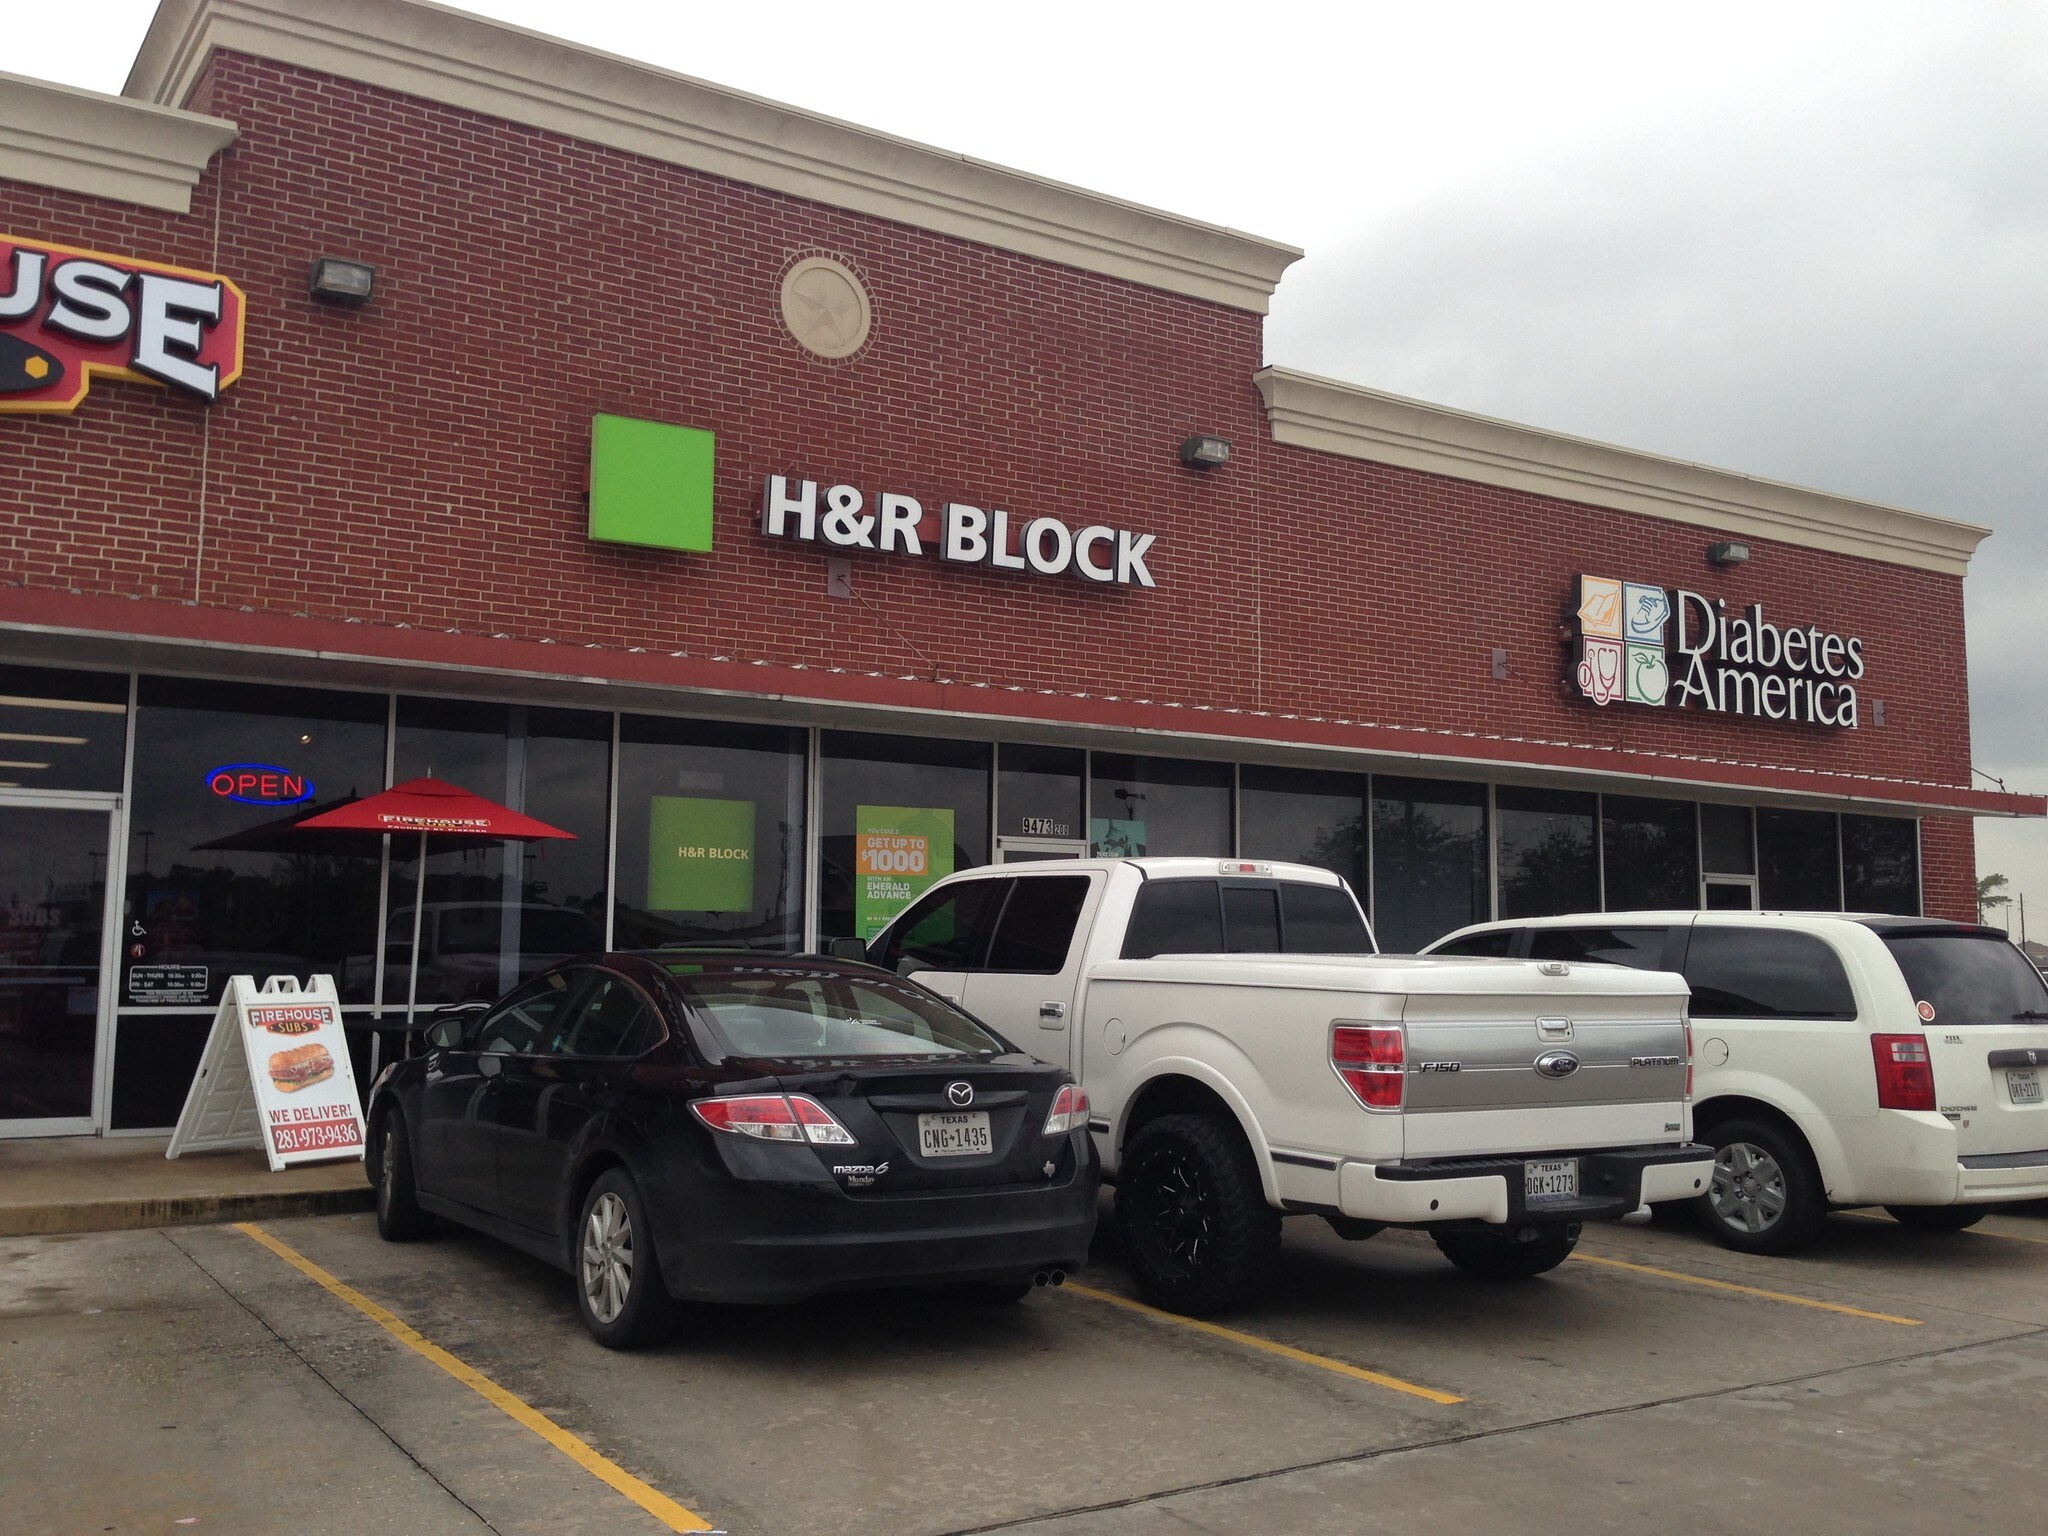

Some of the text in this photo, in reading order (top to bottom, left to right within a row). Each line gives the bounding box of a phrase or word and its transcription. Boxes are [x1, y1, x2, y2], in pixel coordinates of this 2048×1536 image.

[762, 474, 1158, 588] H&R BLOCK
[1676, 589, 1864, 680] Diabetes
[1673, 646, 1858, 730] America
[212, 774, 302, 796] OPEN
[382, 815, 489, 827] FIREHOUSE
[1023, 818, 1069, 835] 9473 200
[867, 837, 926, 850] GET UP TO
[678, 846, 750, 860] H&R BLOCK
[861, 849, 925, 872] $1000
[867, 882, 911, 891] EMERALD
[867, 890, 912, 900] ADVANCE
[250, 1007, 333, 1029] FIREHOUSE
[278, 1021, 309, 1033] SUBS
[1421, 1062, 1461, 1073] F-150
[268, 1103, 353, 1124] WE DELIVER!
[940, 1115, 969, 1125] TEXAS
[275, 1123, 359, 1150] 281-973-9436
[1541, 1163, 1562, 1172] TEXAS
